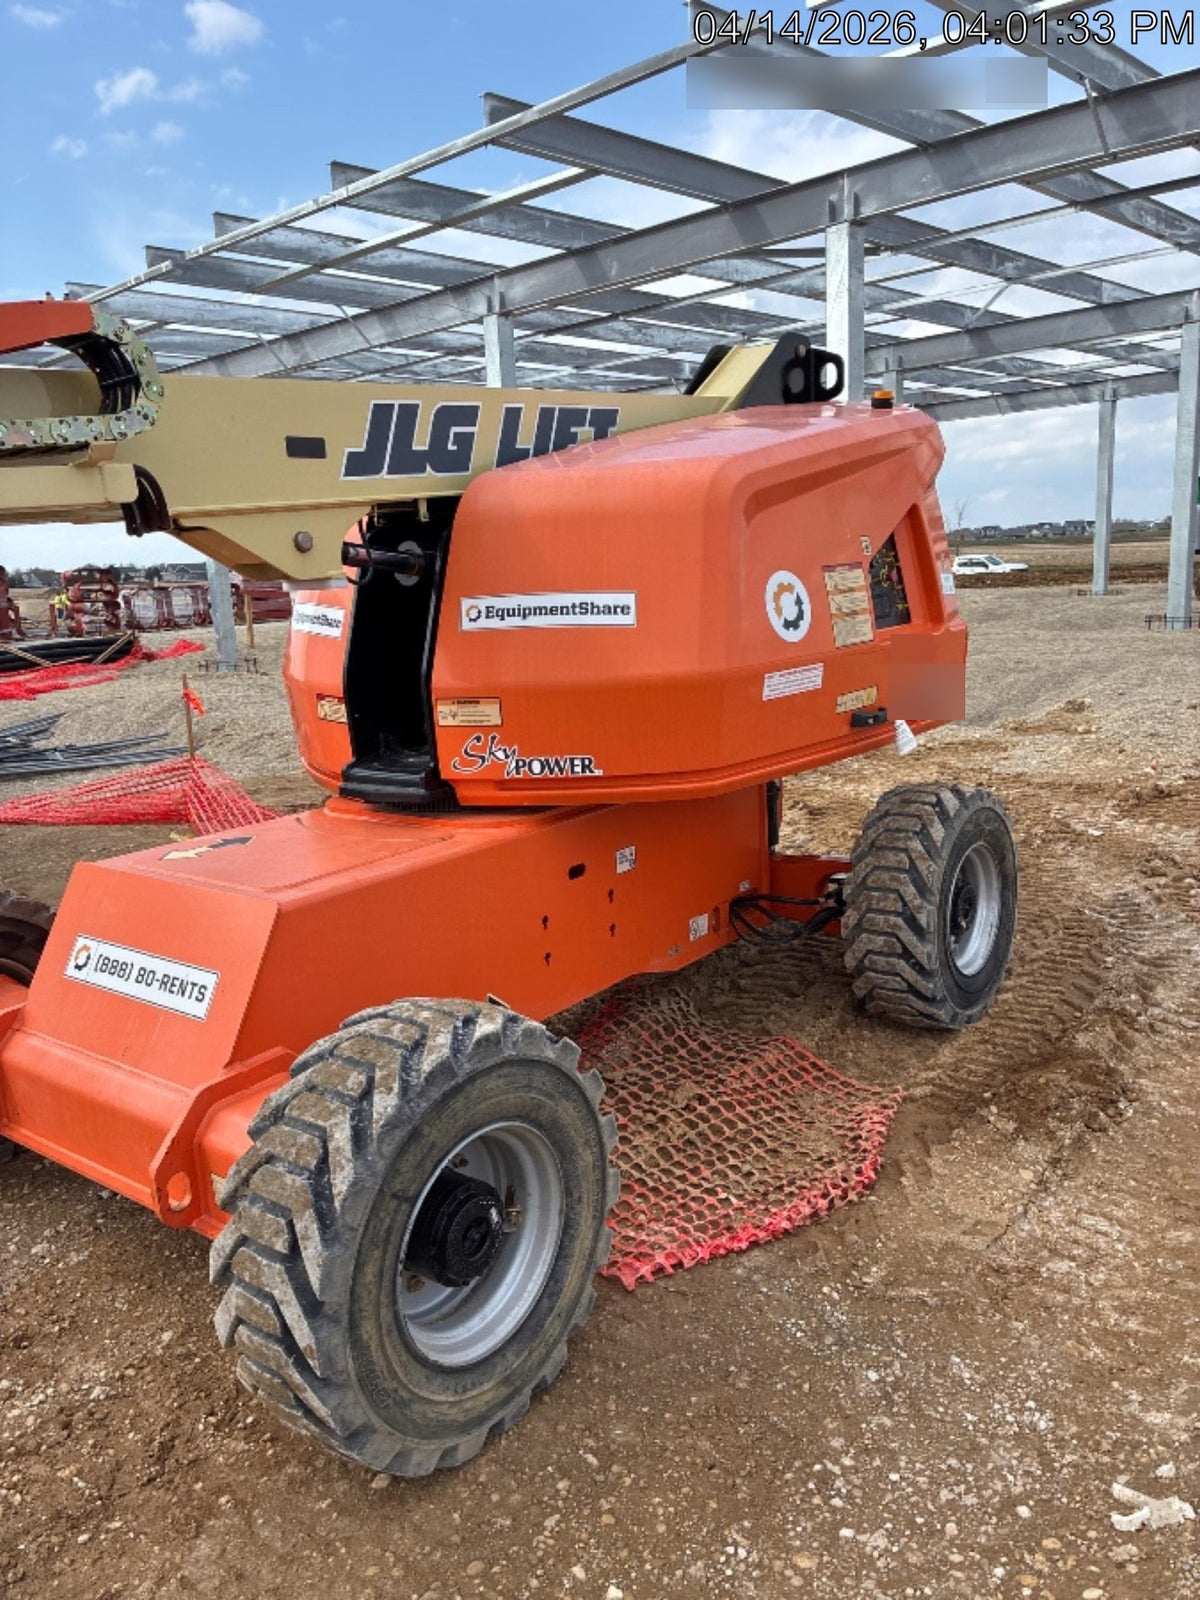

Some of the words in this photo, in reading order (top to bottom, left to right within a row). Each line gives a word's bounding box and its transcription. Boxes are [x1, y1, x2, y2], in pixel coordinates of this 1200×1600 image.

[340, 400, 482, 480] JLG
[484, 602, 631, 621] EquipmentShare
[93, 953, 134, 982] (888)
[135, 966, 208, 1003] 80-RENTS
